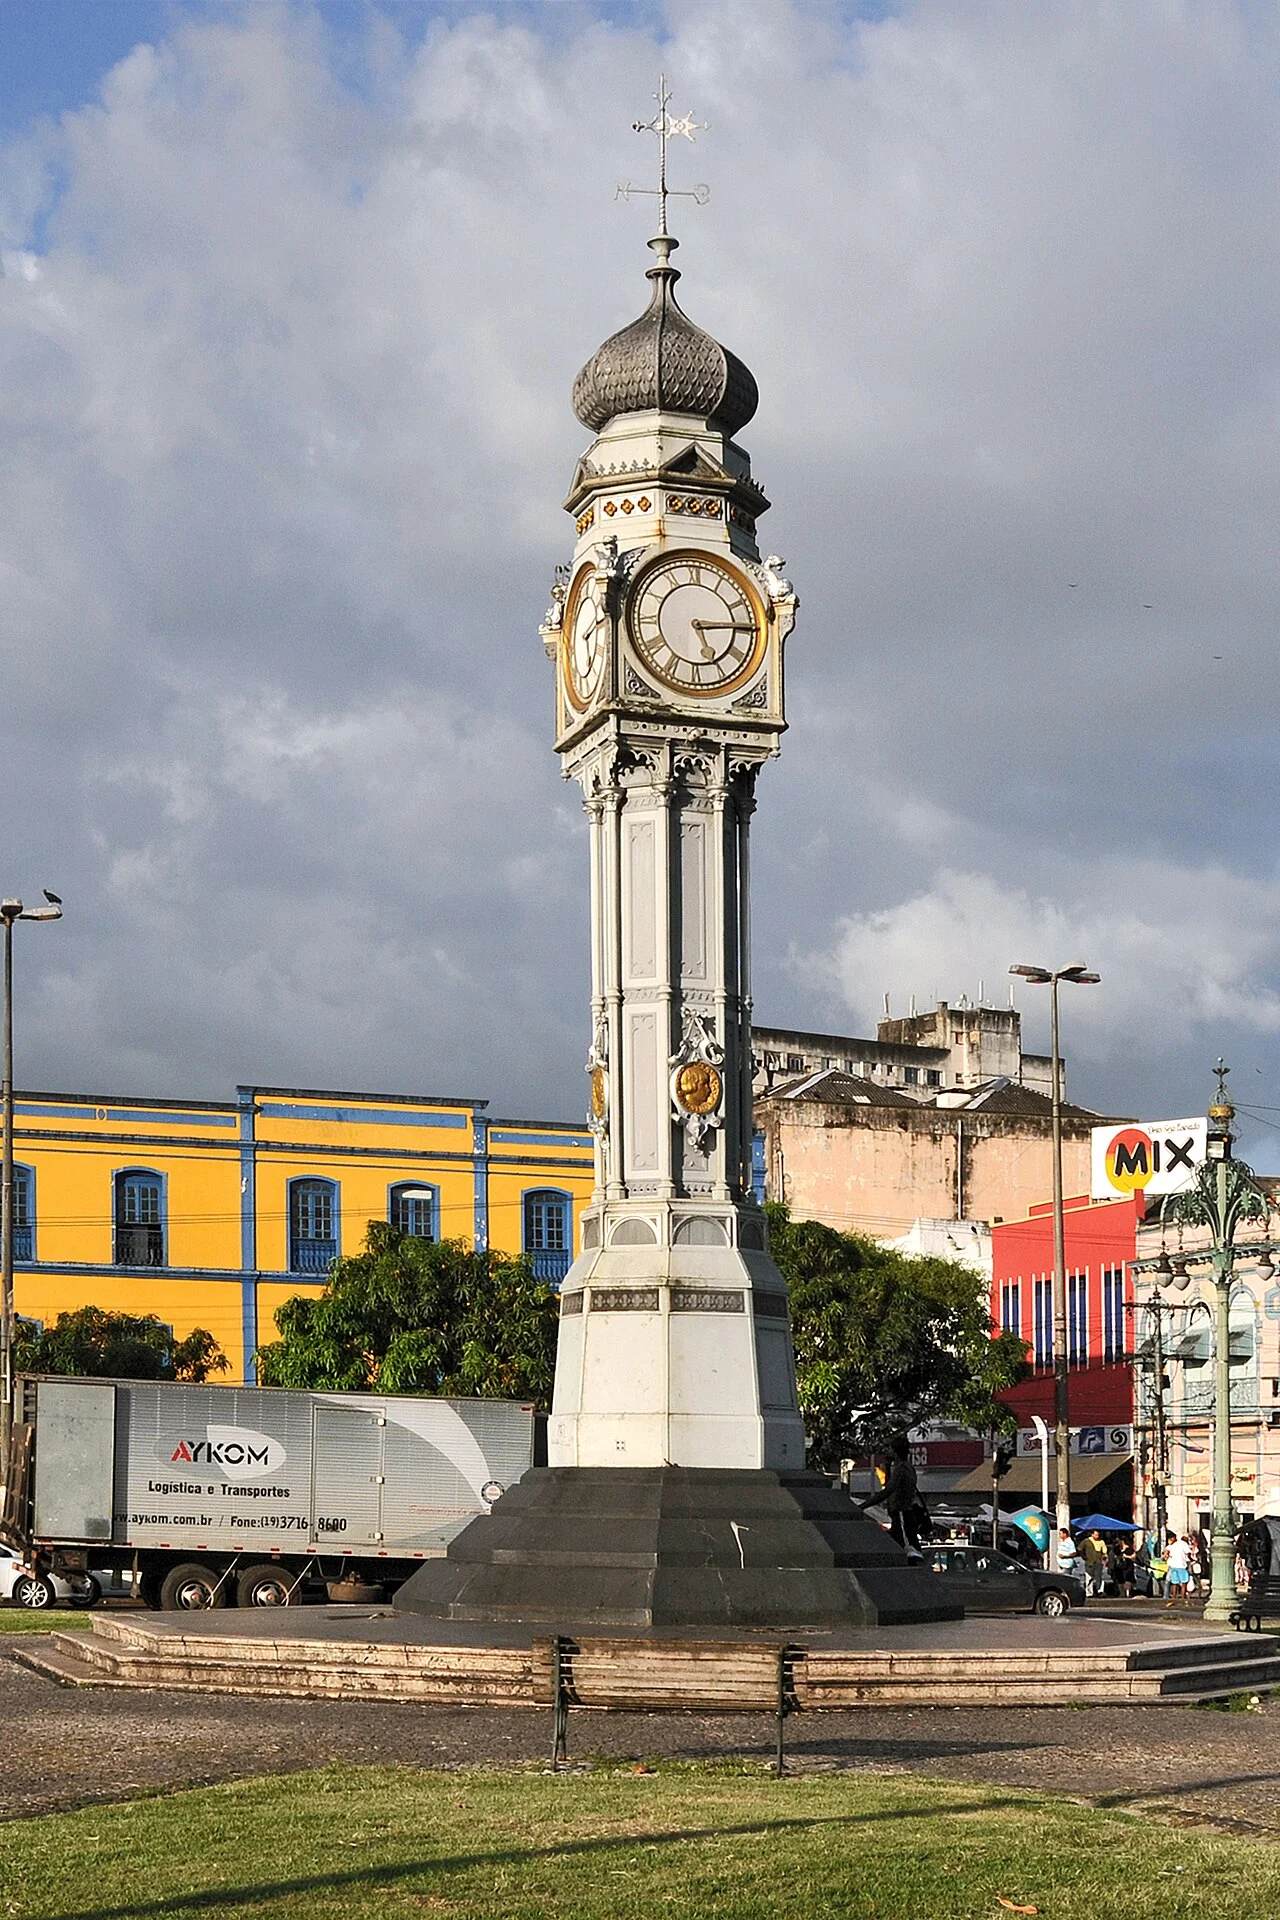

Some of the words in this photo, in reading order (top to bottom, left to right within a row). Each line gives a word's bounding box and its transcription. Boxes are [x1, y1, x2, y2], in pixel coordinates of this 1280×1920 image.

[1114, 1137, 1195, 1177] MIX
[171, 1441, 268, 1465] AYKOM
[207, 1486, 214, 1494] e
[221, 1484, 290, 1498] Transportes
